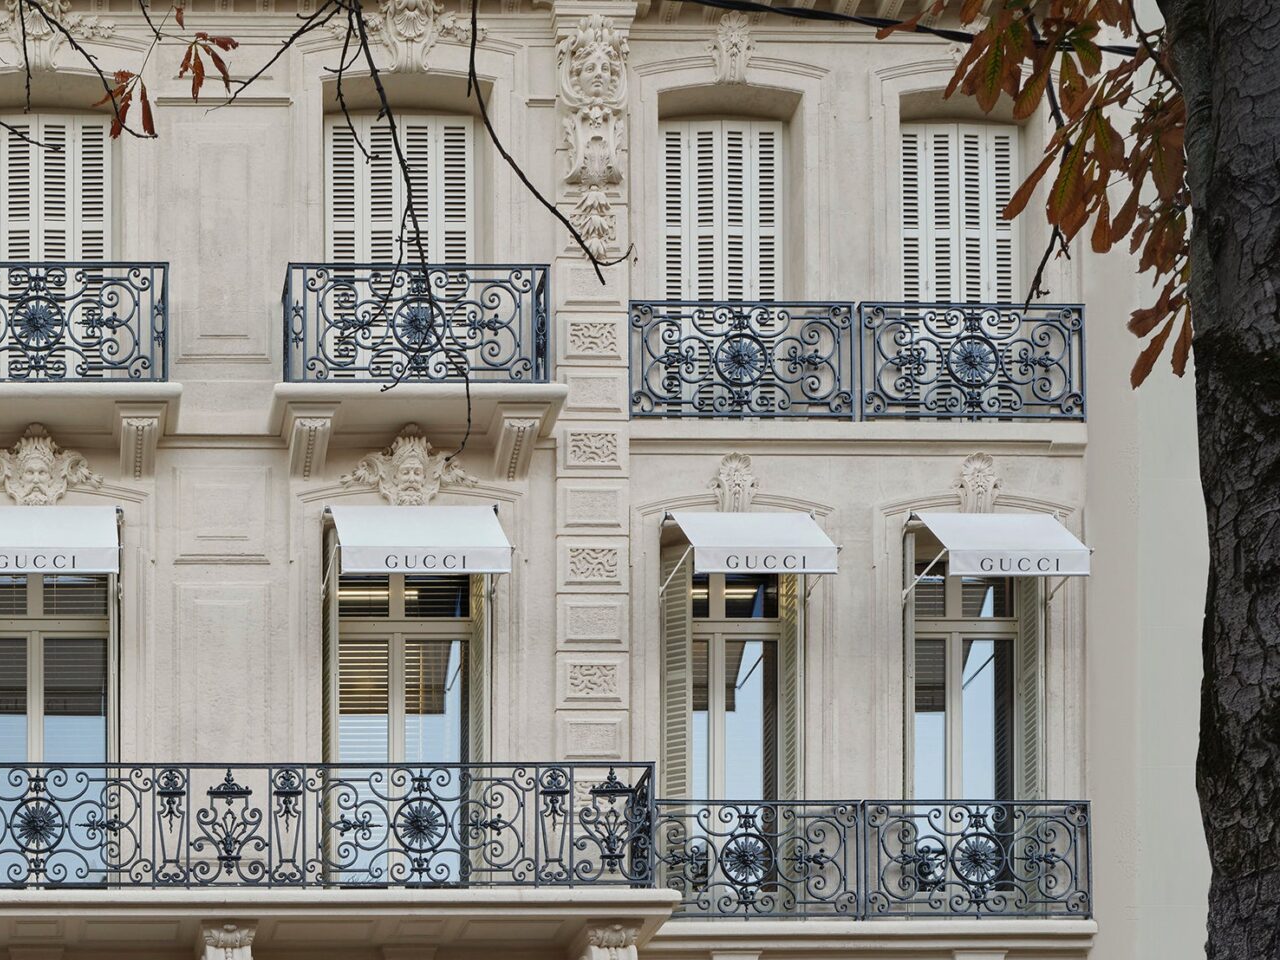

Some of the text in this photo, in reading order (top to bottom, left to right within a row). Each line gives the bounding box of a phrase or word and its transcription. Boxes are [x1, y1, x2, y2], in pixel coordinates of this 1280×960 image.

[384, 555, 466, 569] GUCCI
[726, 555, 806, 569] GUCCI
[979, 557, 1060, 571] GUCCI
